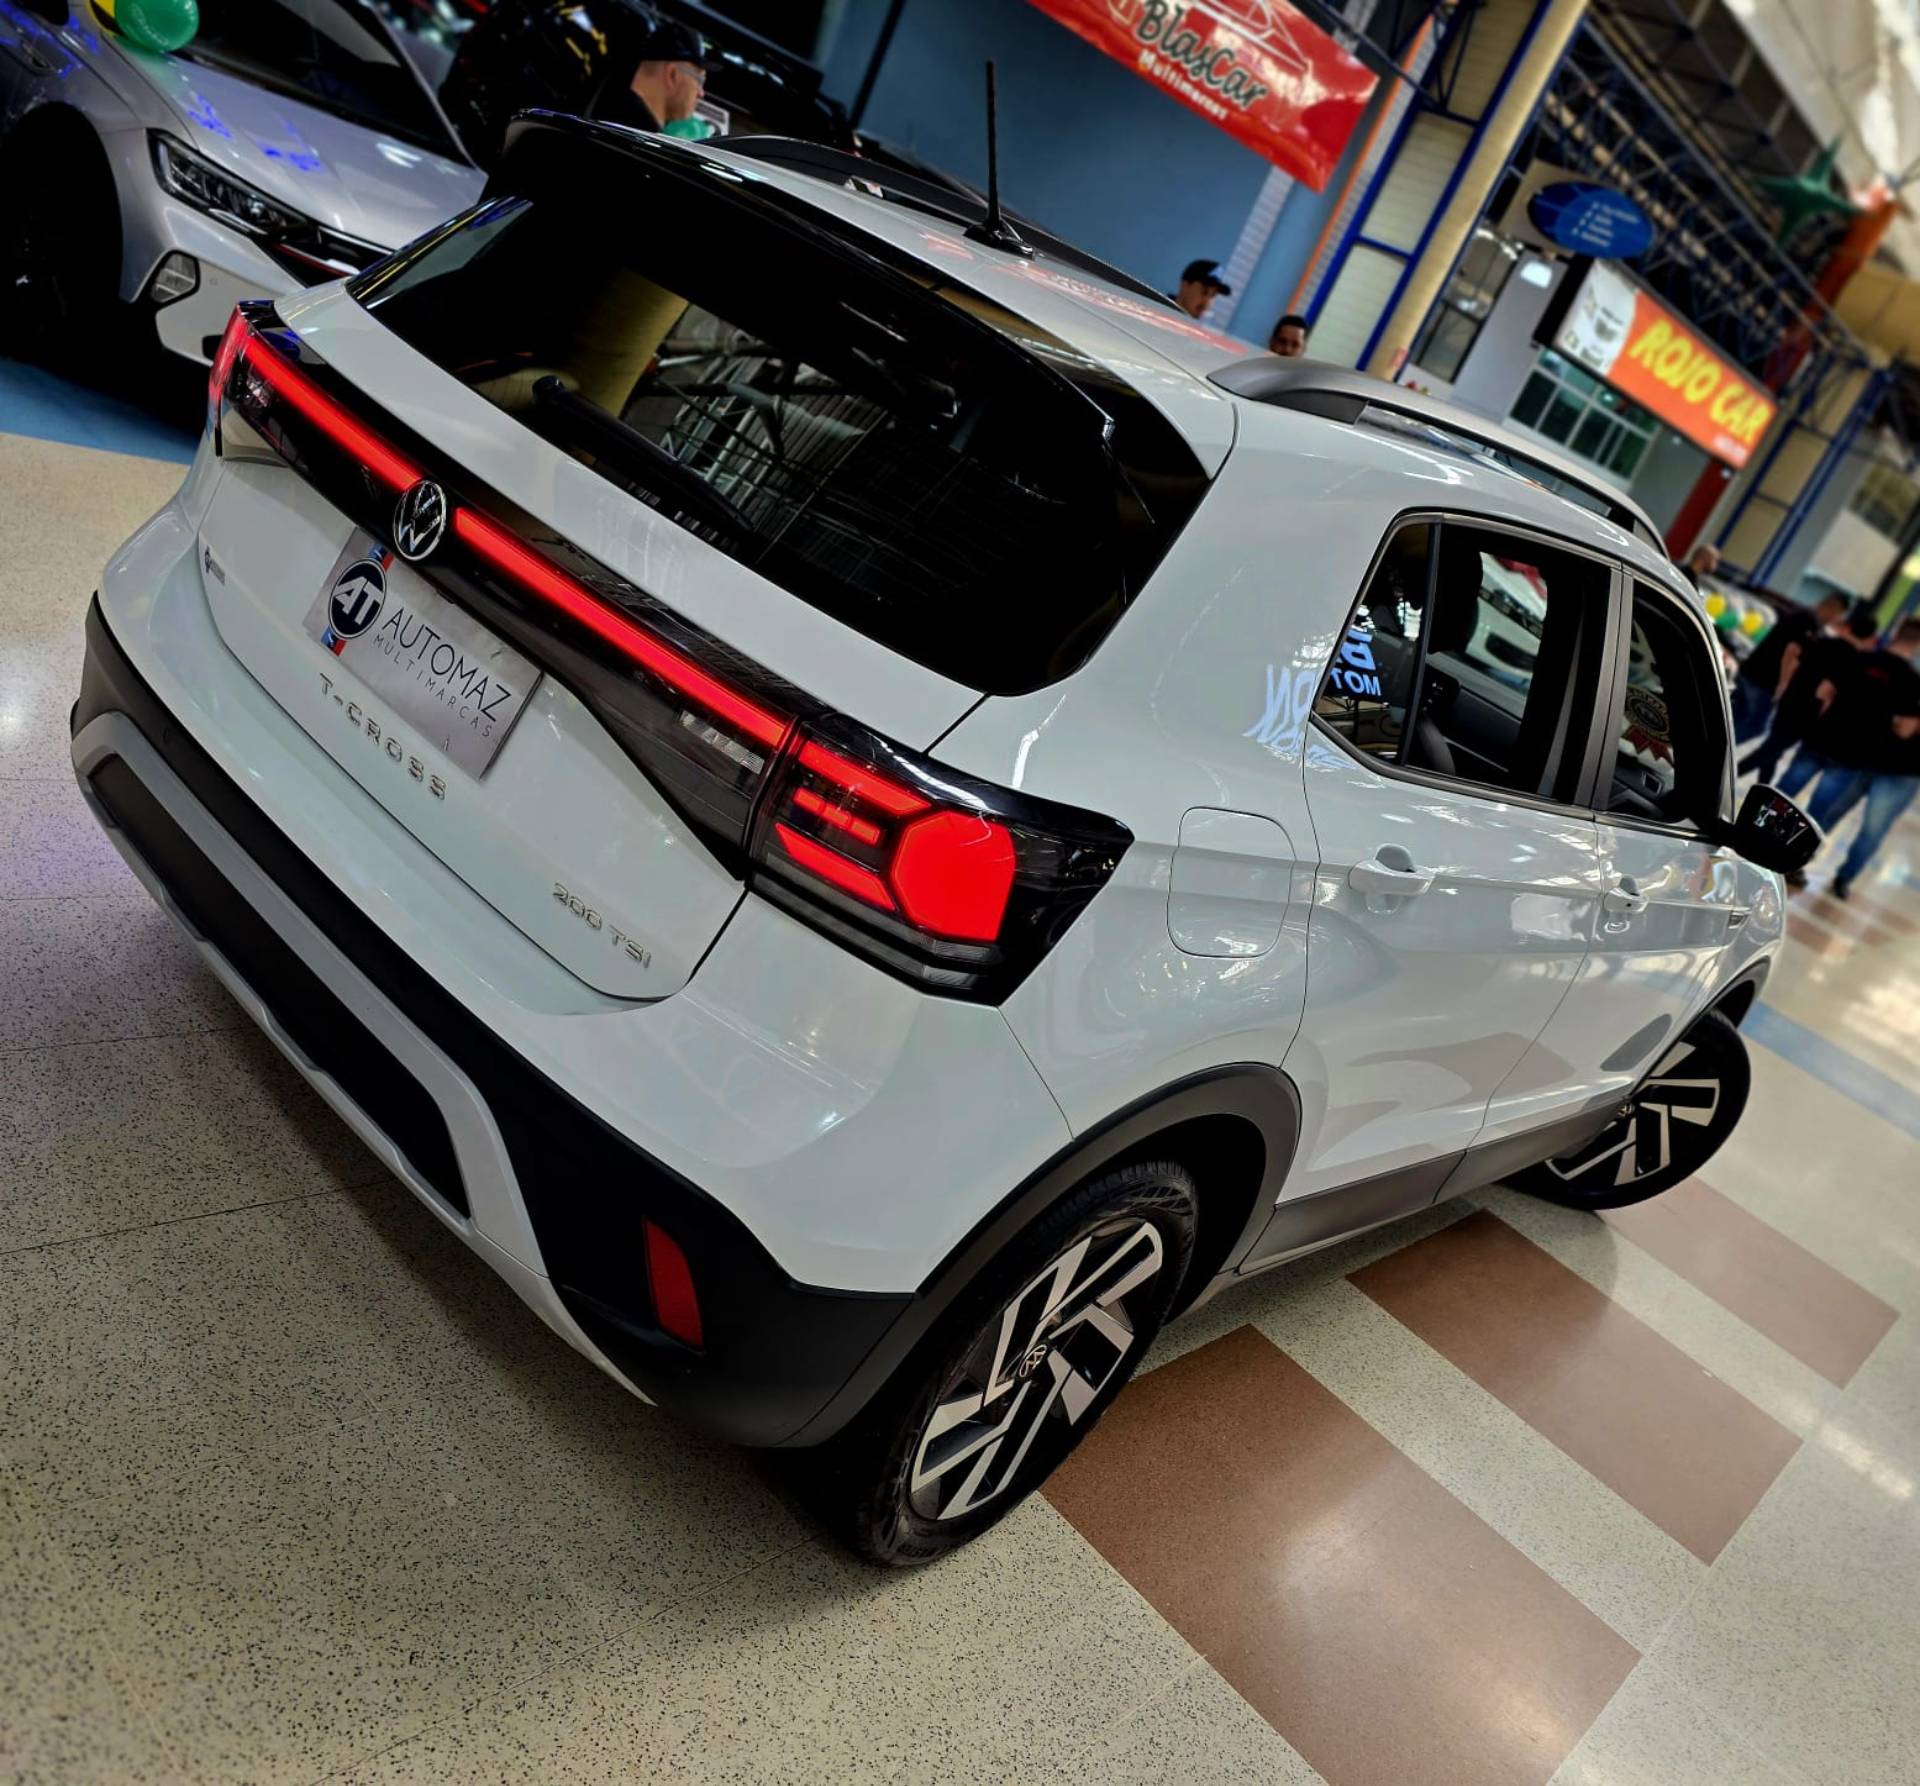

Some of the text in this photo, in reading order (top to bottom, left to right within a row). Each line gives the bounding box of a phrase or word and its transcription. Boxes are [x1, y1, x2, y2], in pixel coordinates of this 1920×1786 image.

[1136, 0, 1269, 109] BlasCar
[1629, 317, 1771, 445] ROJO CAR
[373, 634, 493, 738] MULTIMARCAS
[382, 607, 512, 722] AUTOMAZ
[319, 672, 447, 801] T-CROSS
[553, 882, 652, 969] 200 TSI
